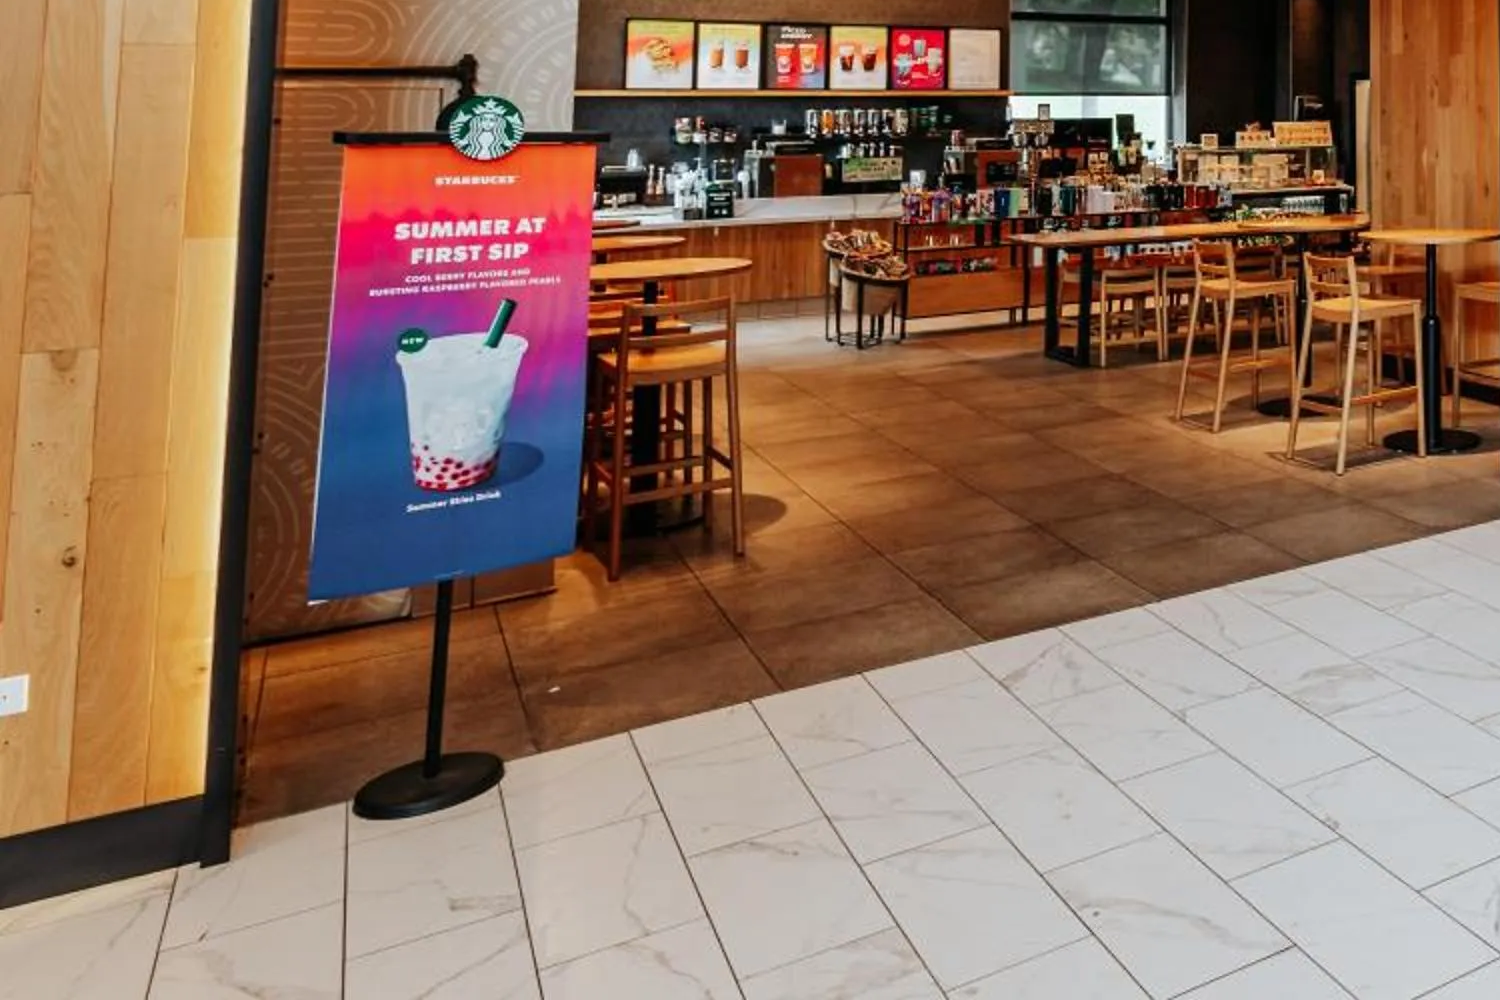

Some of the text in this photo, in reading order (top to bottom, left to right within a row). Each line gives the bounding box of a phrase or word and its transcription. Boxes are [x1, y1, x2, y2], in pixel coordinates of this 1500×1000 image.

[435, 175, 516, 186] STARBUCKS
[394, 217, 547, 240] SUMMER AT
[411, 243, 529, 264] FIRST SIP
[405, 275, 432, 283] COOL
[421, 282, 477, 293] RASPBERRY
[402, 337, 424, 345] NEW
[406, 501, 446, 512] Summer
